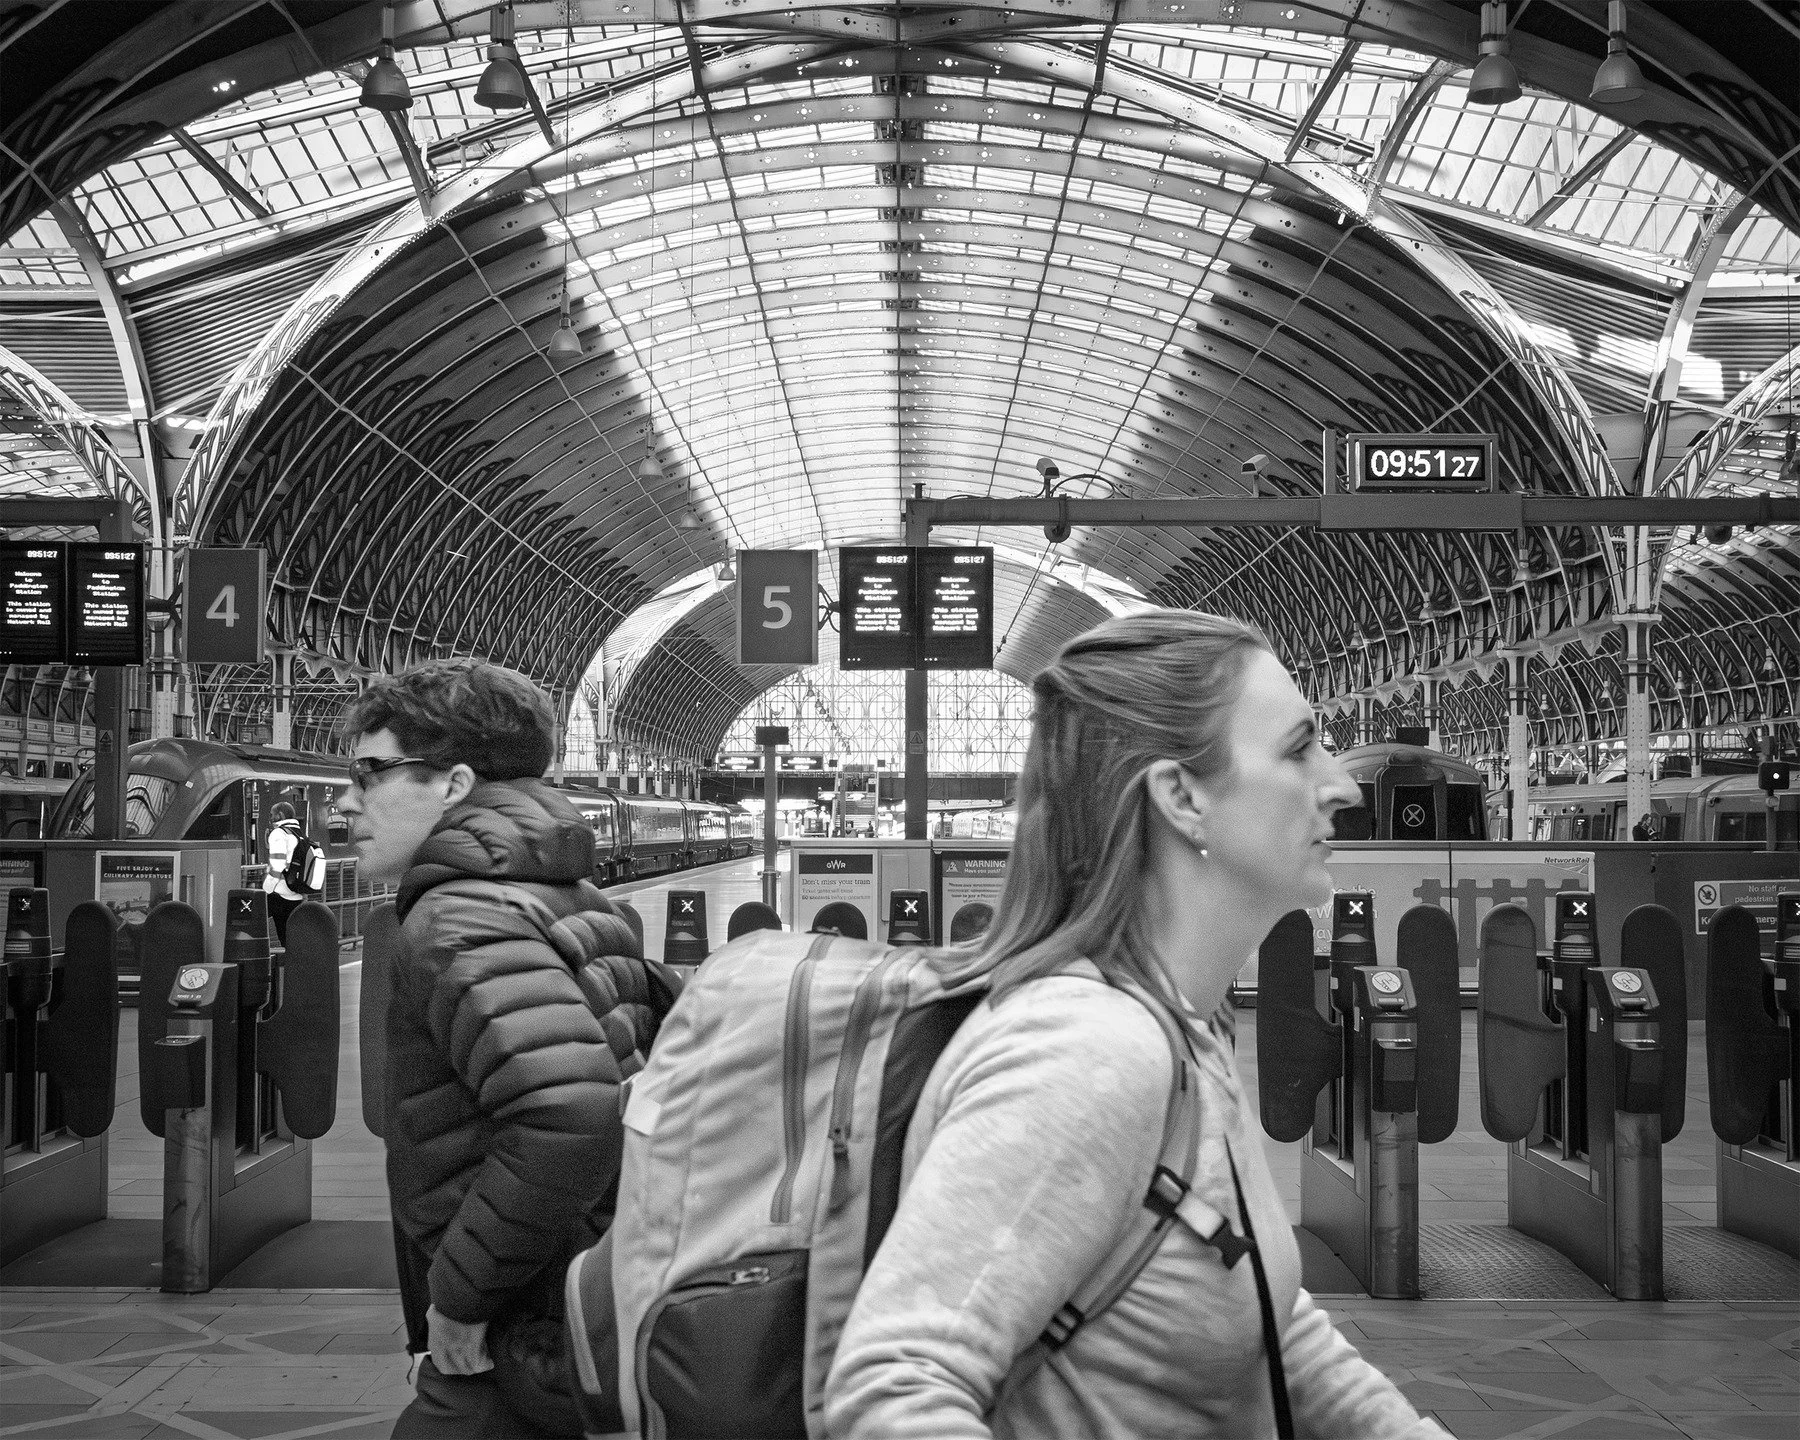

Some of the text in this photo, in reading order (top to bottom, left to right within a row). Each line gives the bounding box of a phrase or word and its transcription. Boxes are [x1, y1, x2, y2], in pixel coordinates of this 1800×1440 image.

[1370, 449, 1480, 478] 09:51 27
[205, 584, 240, 628] 4
[762, 585, 793, 630] 5
[0, 860, 29, 868] RNING
[826, 859, 846, 870] GWR
[964, 860, 1006, 868] WARNING
[1761, 884, 1777, 892] staff
[1734, 896, 1774, 904] pedestrian
